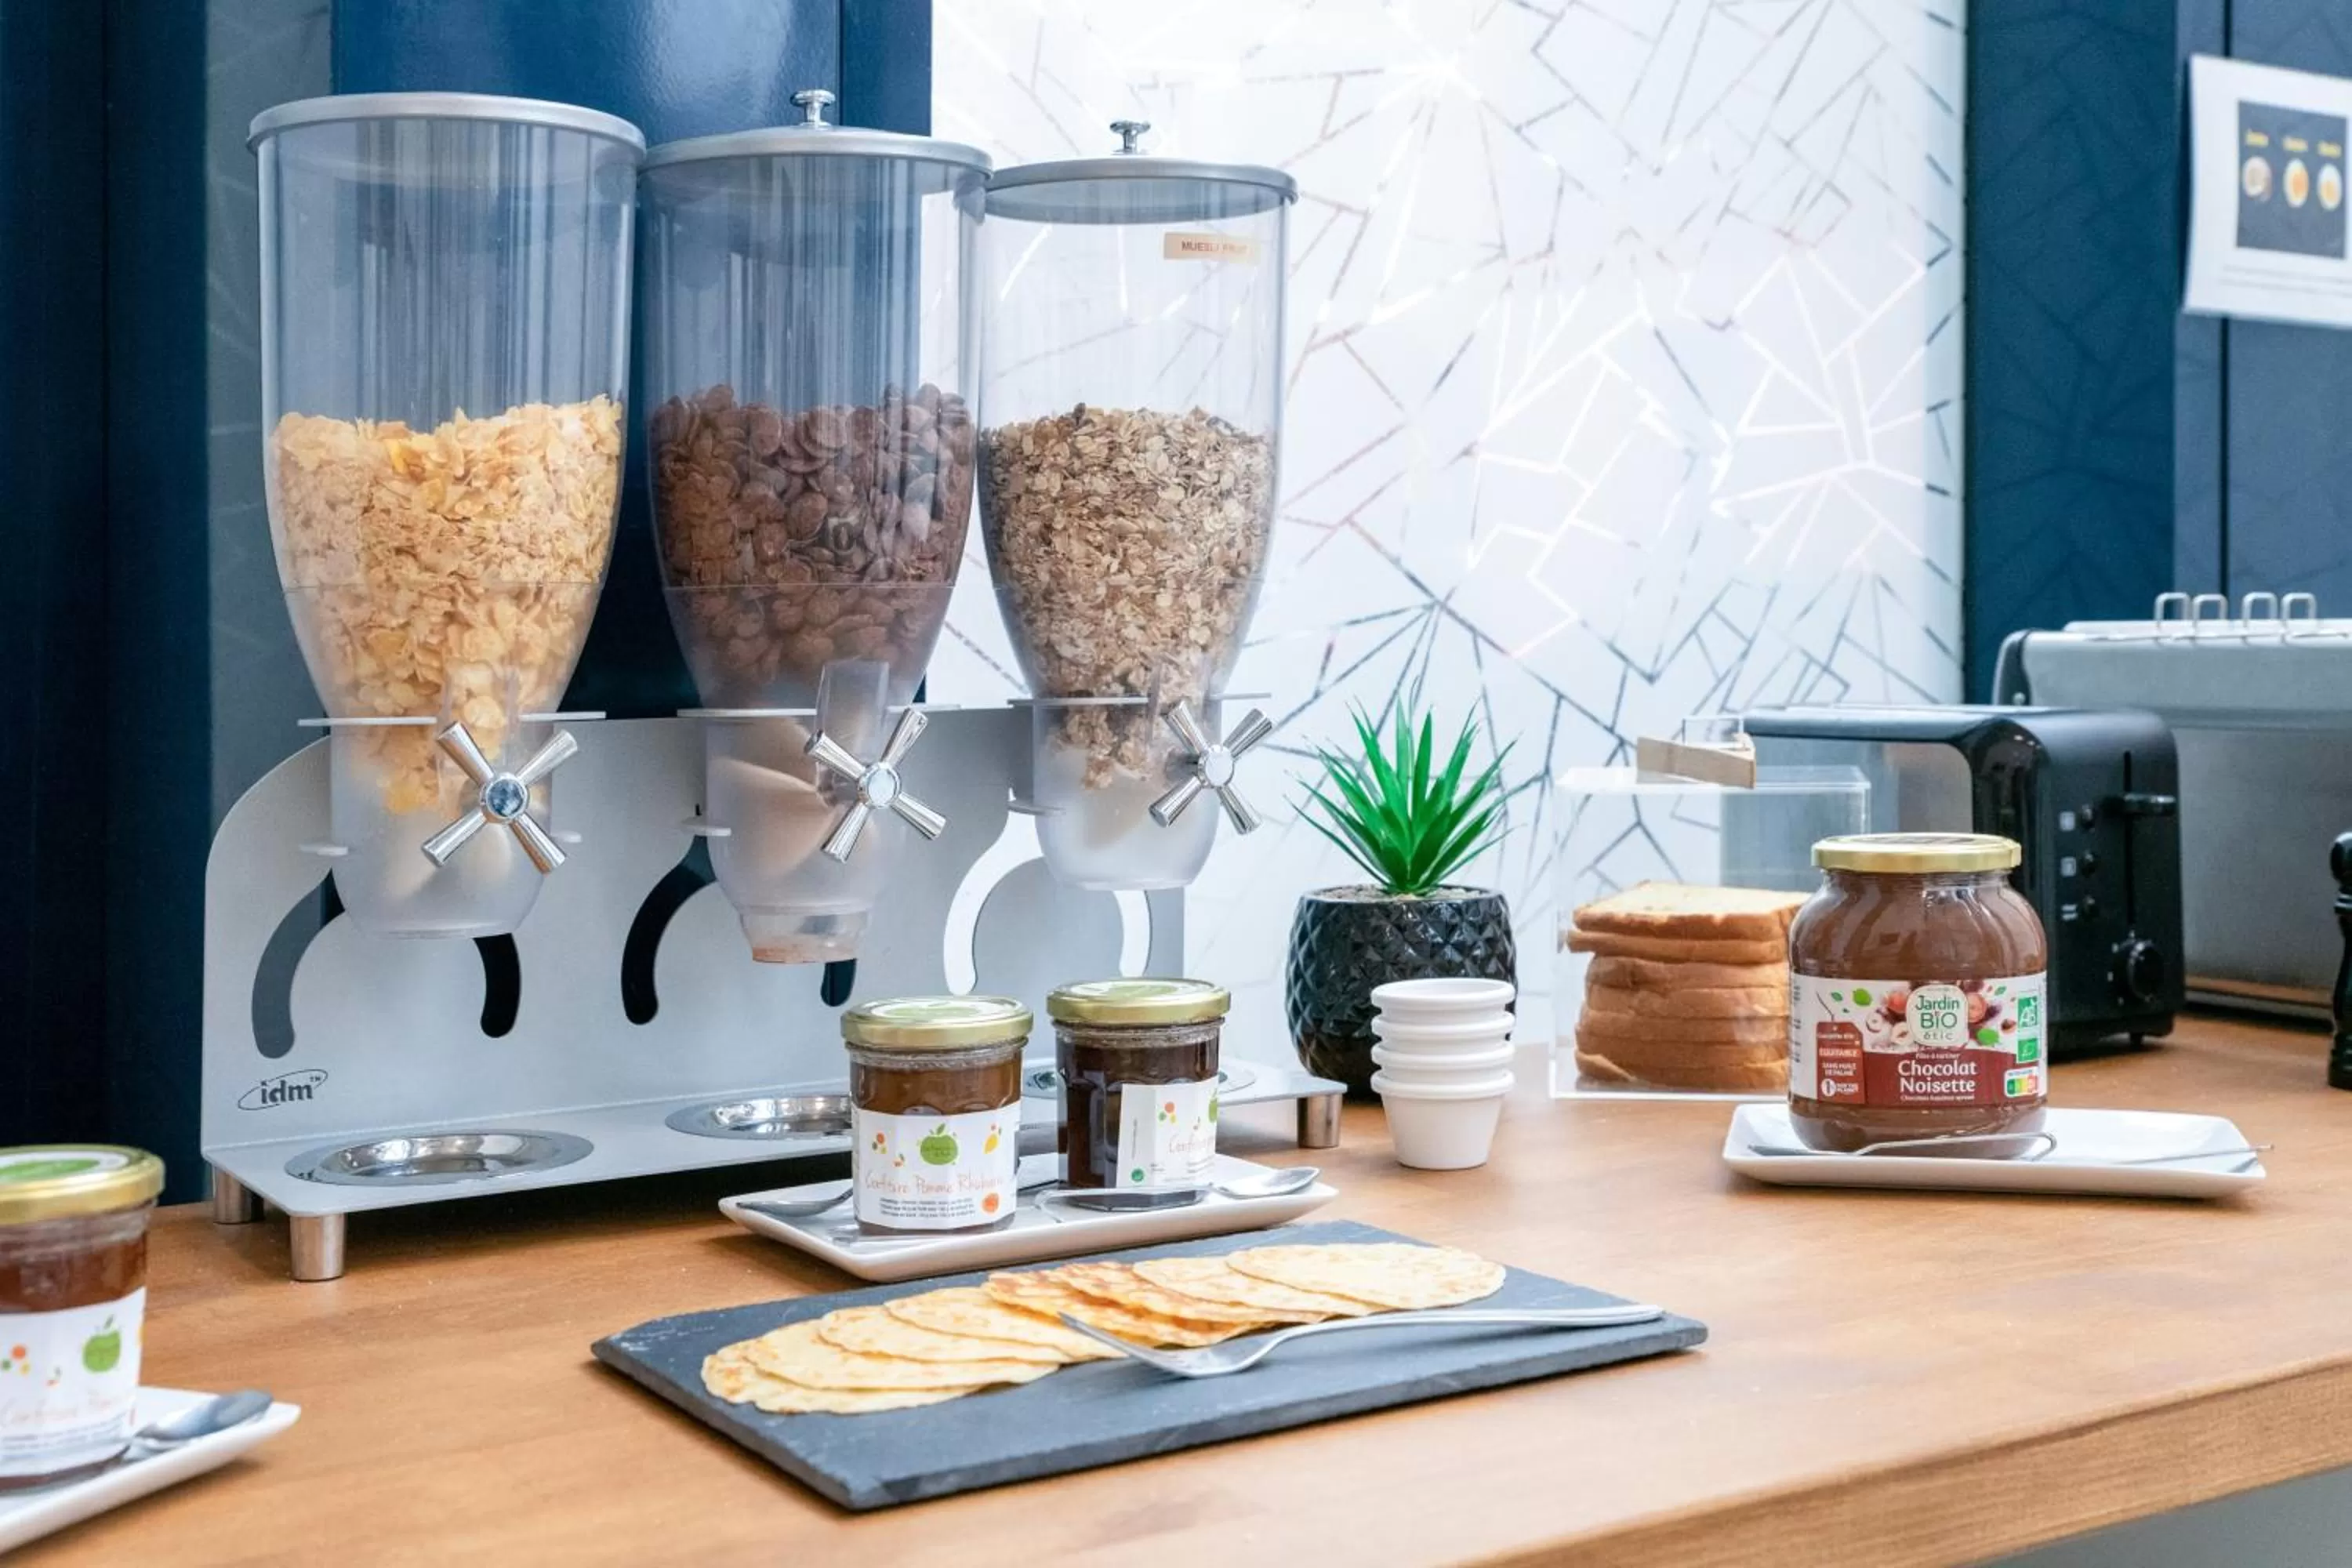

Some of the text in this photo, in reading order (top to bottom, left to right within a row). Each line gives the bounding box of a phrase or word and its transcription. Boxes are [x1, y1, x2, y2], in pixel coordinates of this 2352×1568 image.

[1915, 994, 1960, 1011] Jardin
[1898, 1059, 1978, 1076] Chocolat
[260, 1079, 314, 1105] idm
[1900, 1076, 1976, 1093] Noisette
